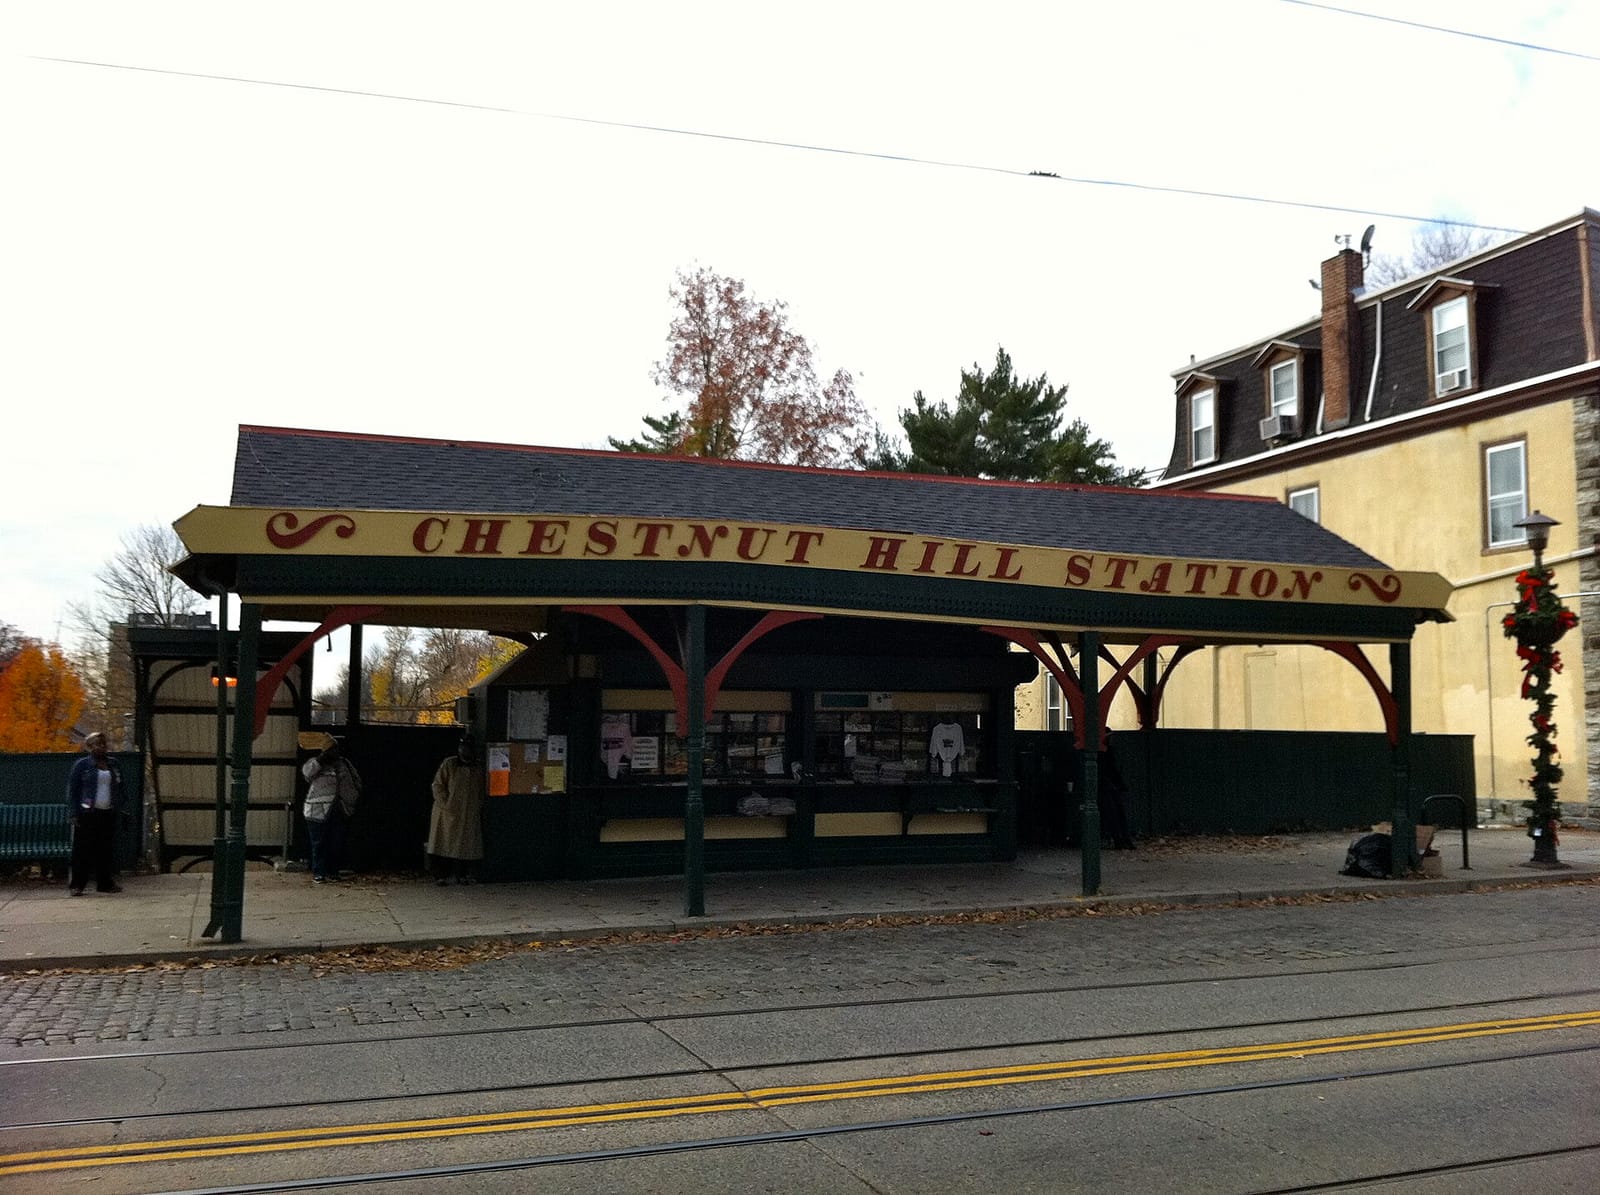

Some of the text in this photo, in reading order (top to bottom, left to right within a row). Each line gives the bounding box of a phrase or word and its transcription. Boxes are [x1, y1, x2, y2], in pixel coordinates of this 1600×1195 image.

[413, 517, 1322, 600] CHESTNUT HILL STATION
